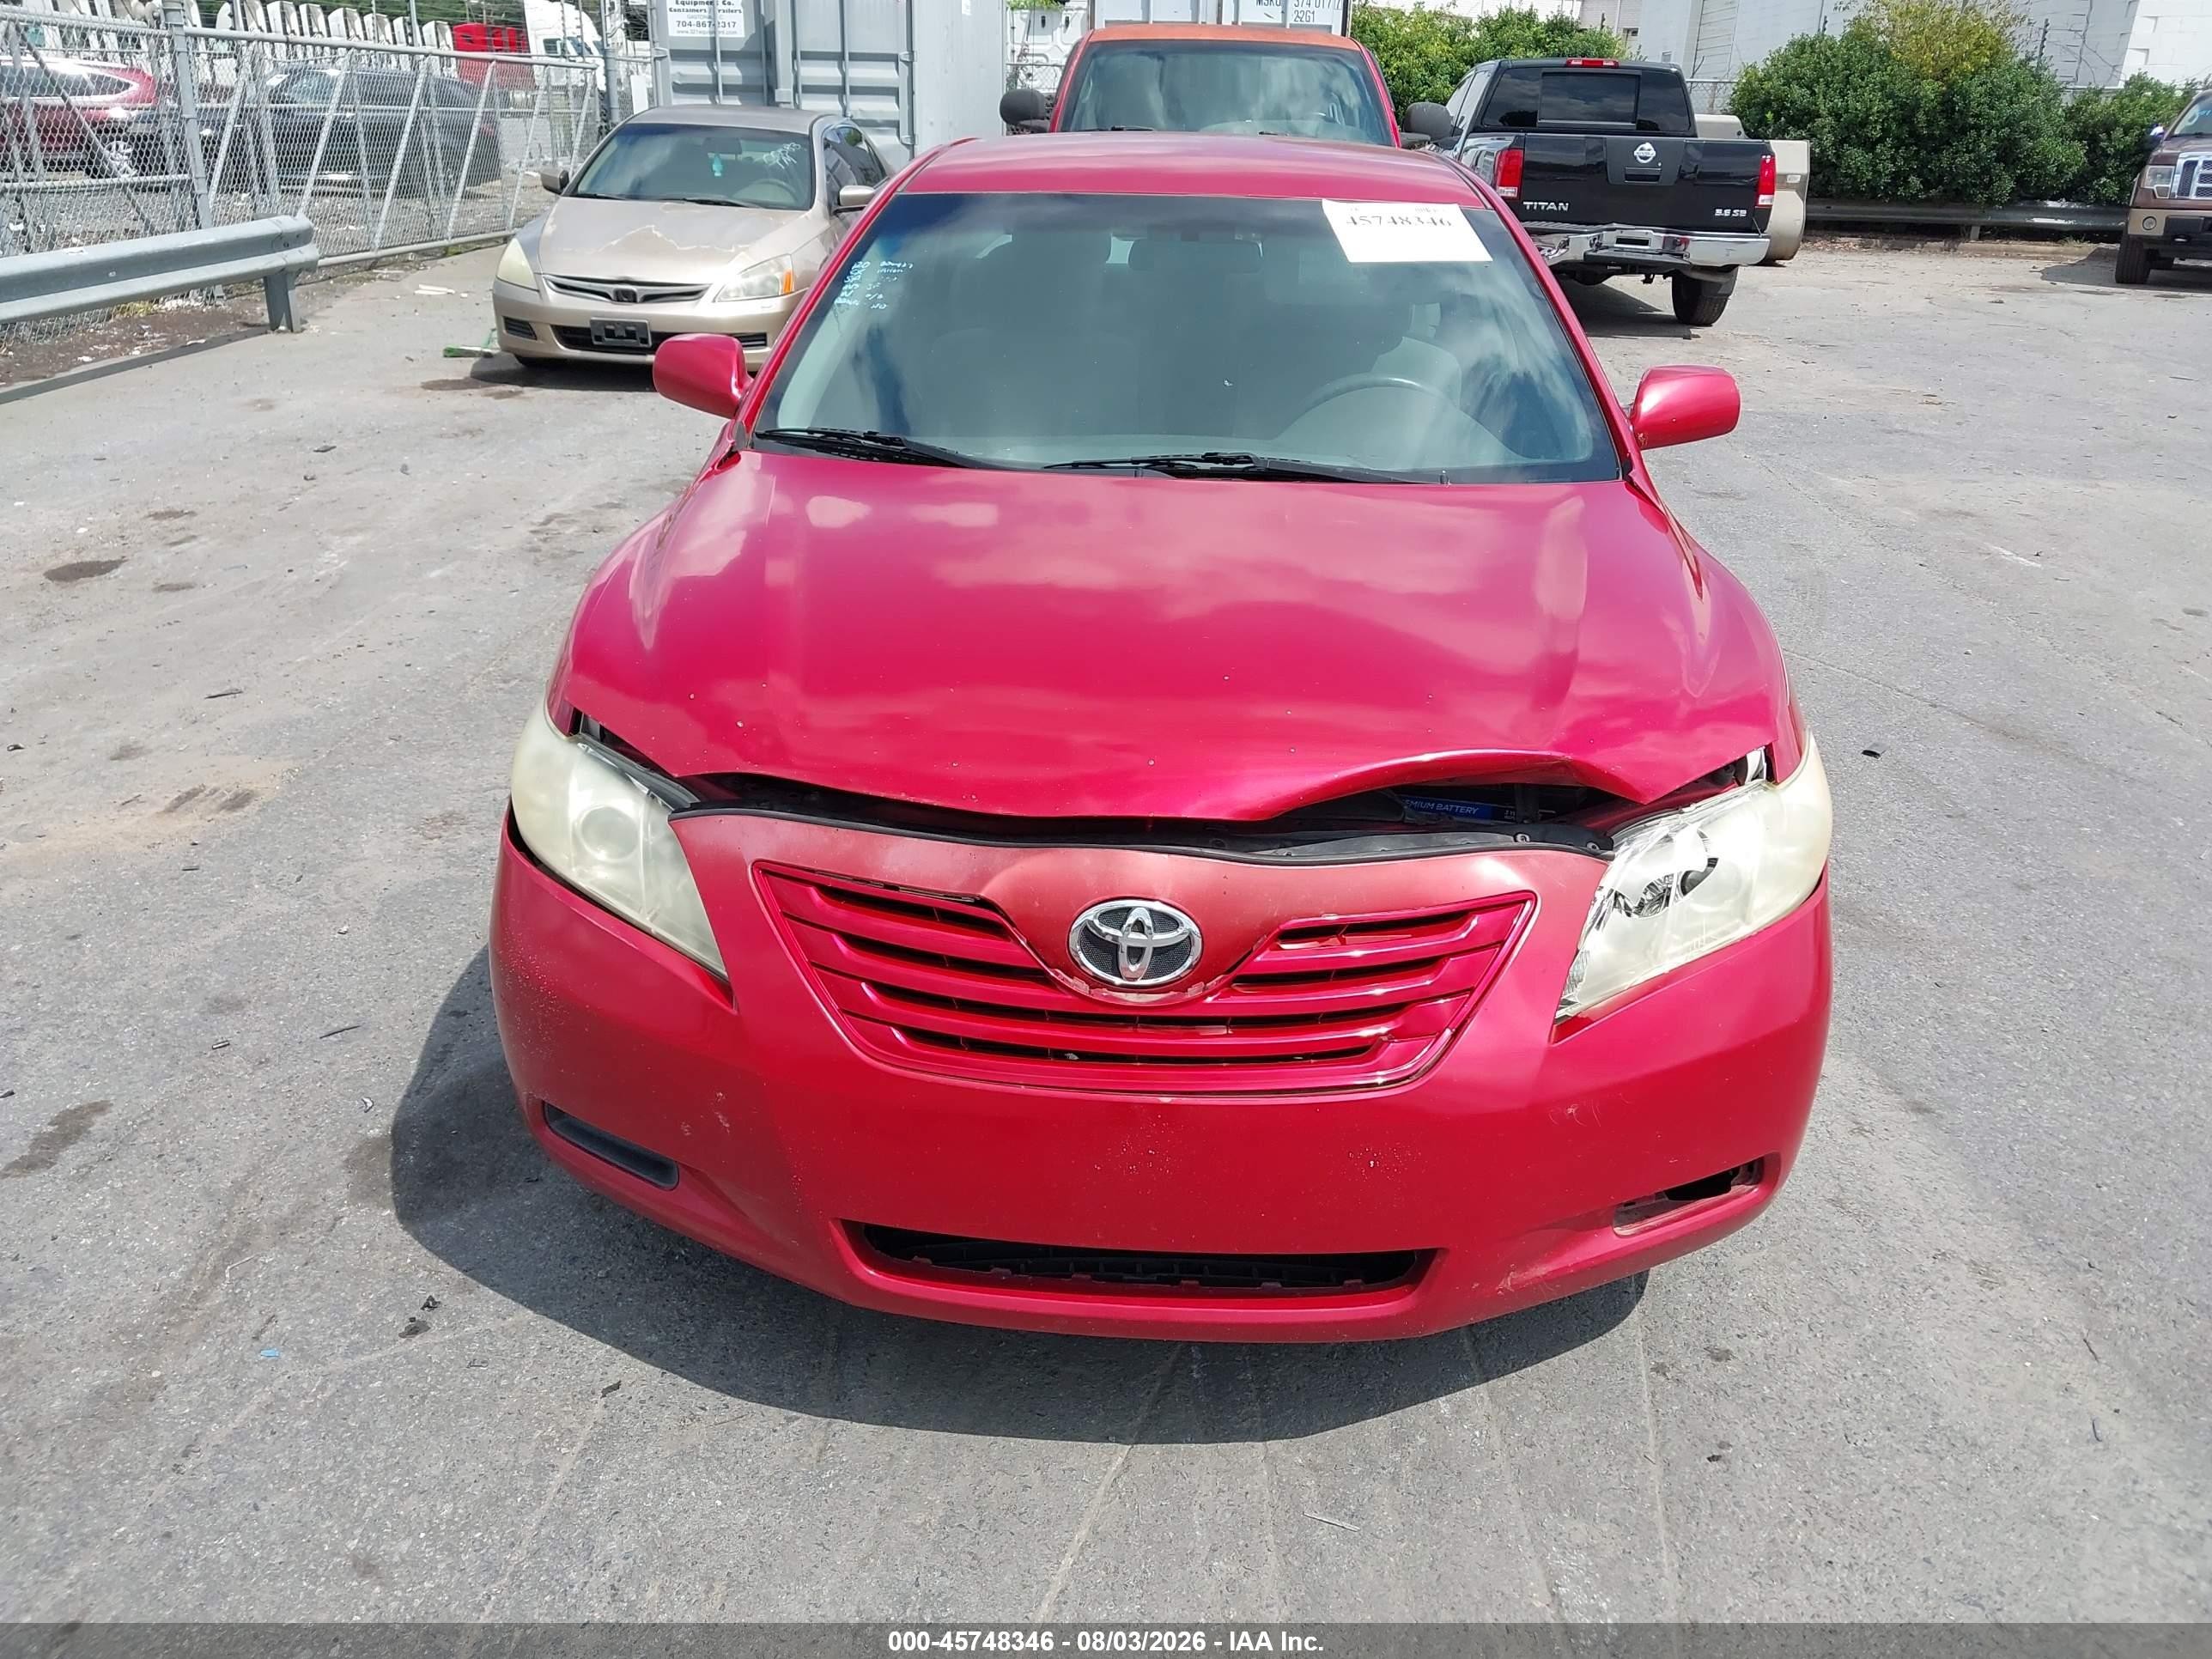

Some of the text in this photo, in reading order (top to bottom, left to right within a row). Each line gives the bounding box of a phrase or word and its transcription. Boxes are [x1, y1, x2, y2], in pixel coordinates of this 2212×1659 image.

[1294, 9, 1315, 22] 22G1
[1523, 201, 1569, 211] TITAN
[1403, 799, 1479, 814] EMIUM BATTERY
